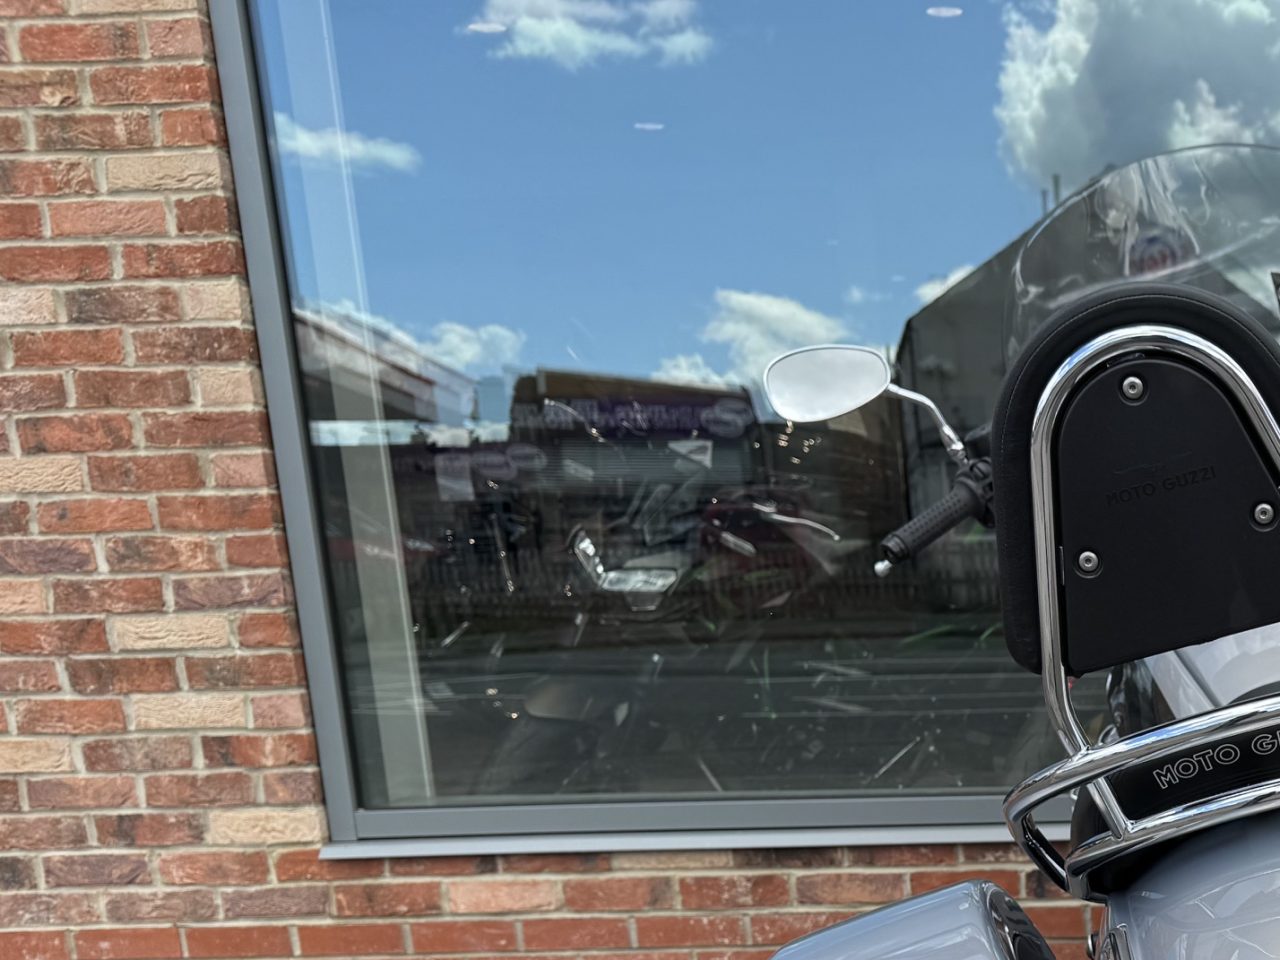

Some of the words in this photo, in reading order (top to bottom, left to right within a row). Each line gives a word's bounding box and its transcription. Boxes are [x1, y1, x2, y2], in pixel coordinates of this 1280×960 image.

[1105, 482, 1156, 507] MOTO
[1162, 466, 1216, 491] GUZZI
[1152, 743, 1241, 790] MOTO
